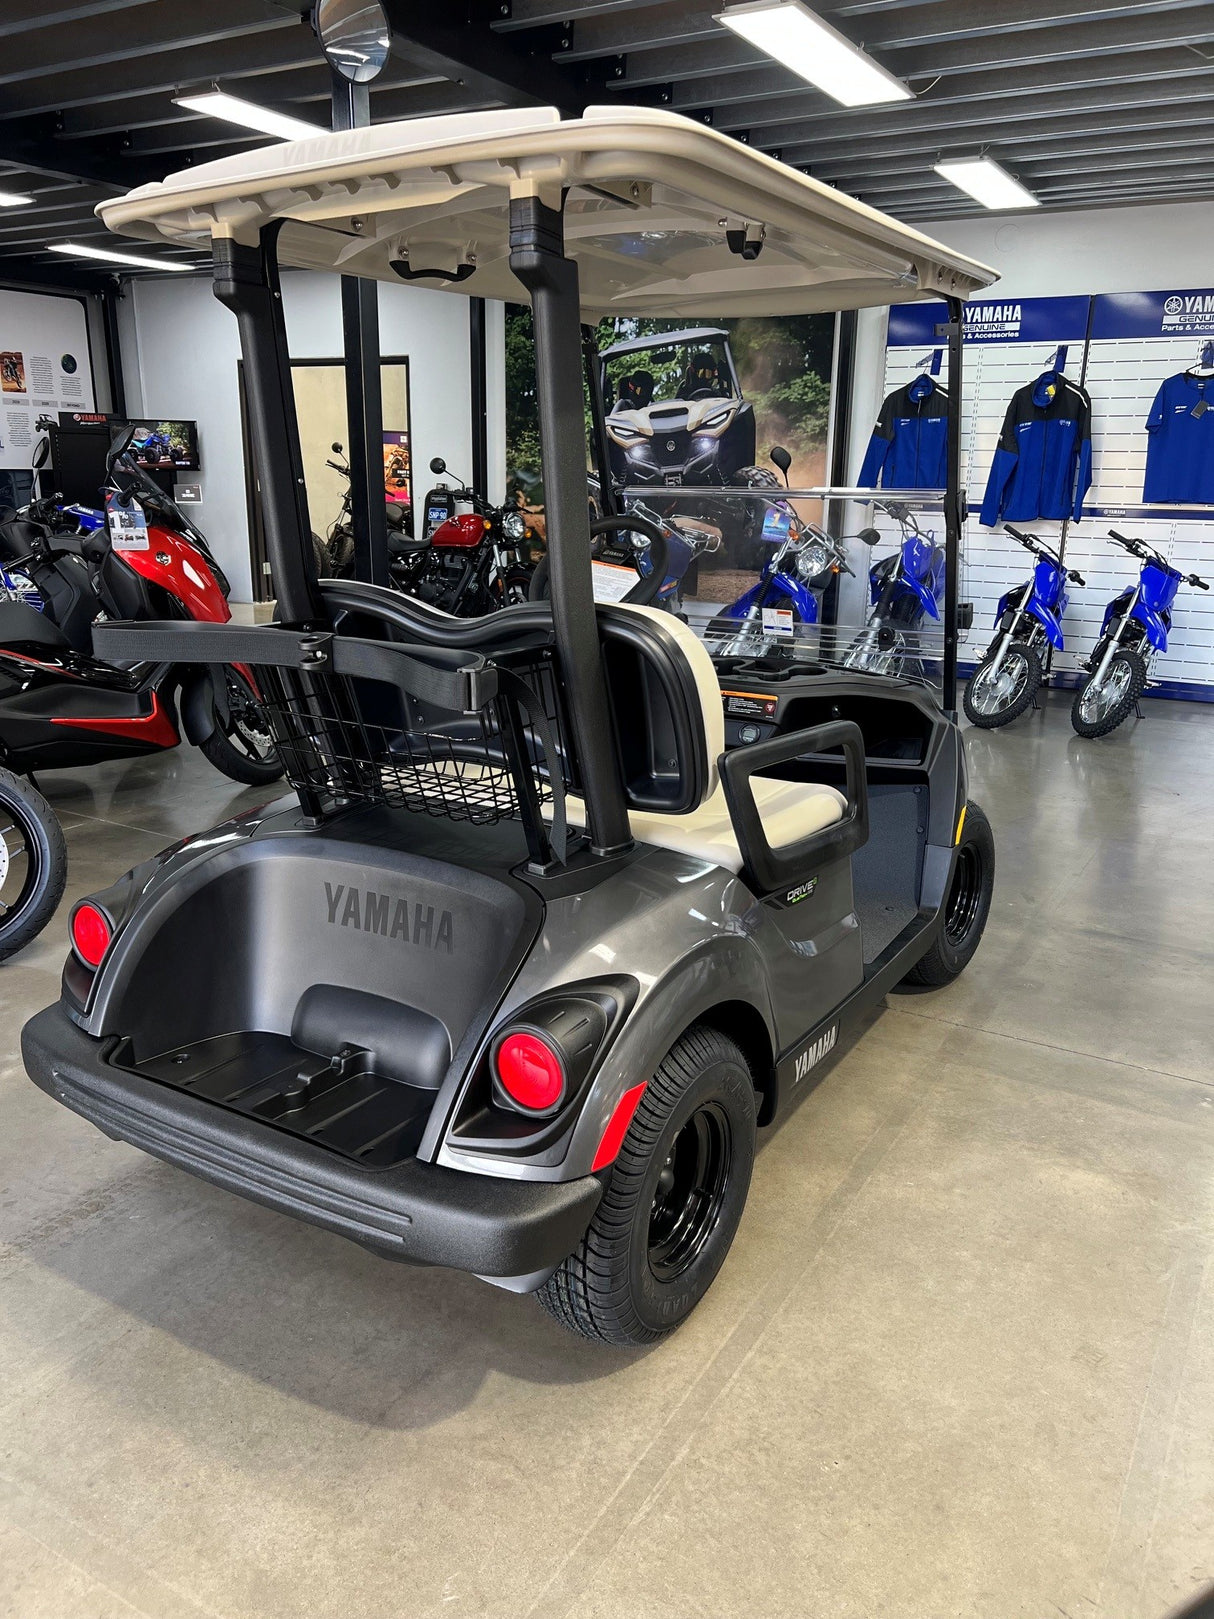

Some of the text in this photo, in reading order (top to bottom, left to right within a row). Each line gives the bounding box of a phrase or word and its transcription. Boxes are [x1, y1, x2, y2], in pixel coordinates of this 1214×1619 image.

[965, 305, 1022, 323] YAMAHA
[974, 331, 1019, 339] Accessories
[80, 414, 107, 422] YAMAHA
[324, 881, 454, 955] YAMAHA
[795, 1025, 836, 1083] YAMAHA
